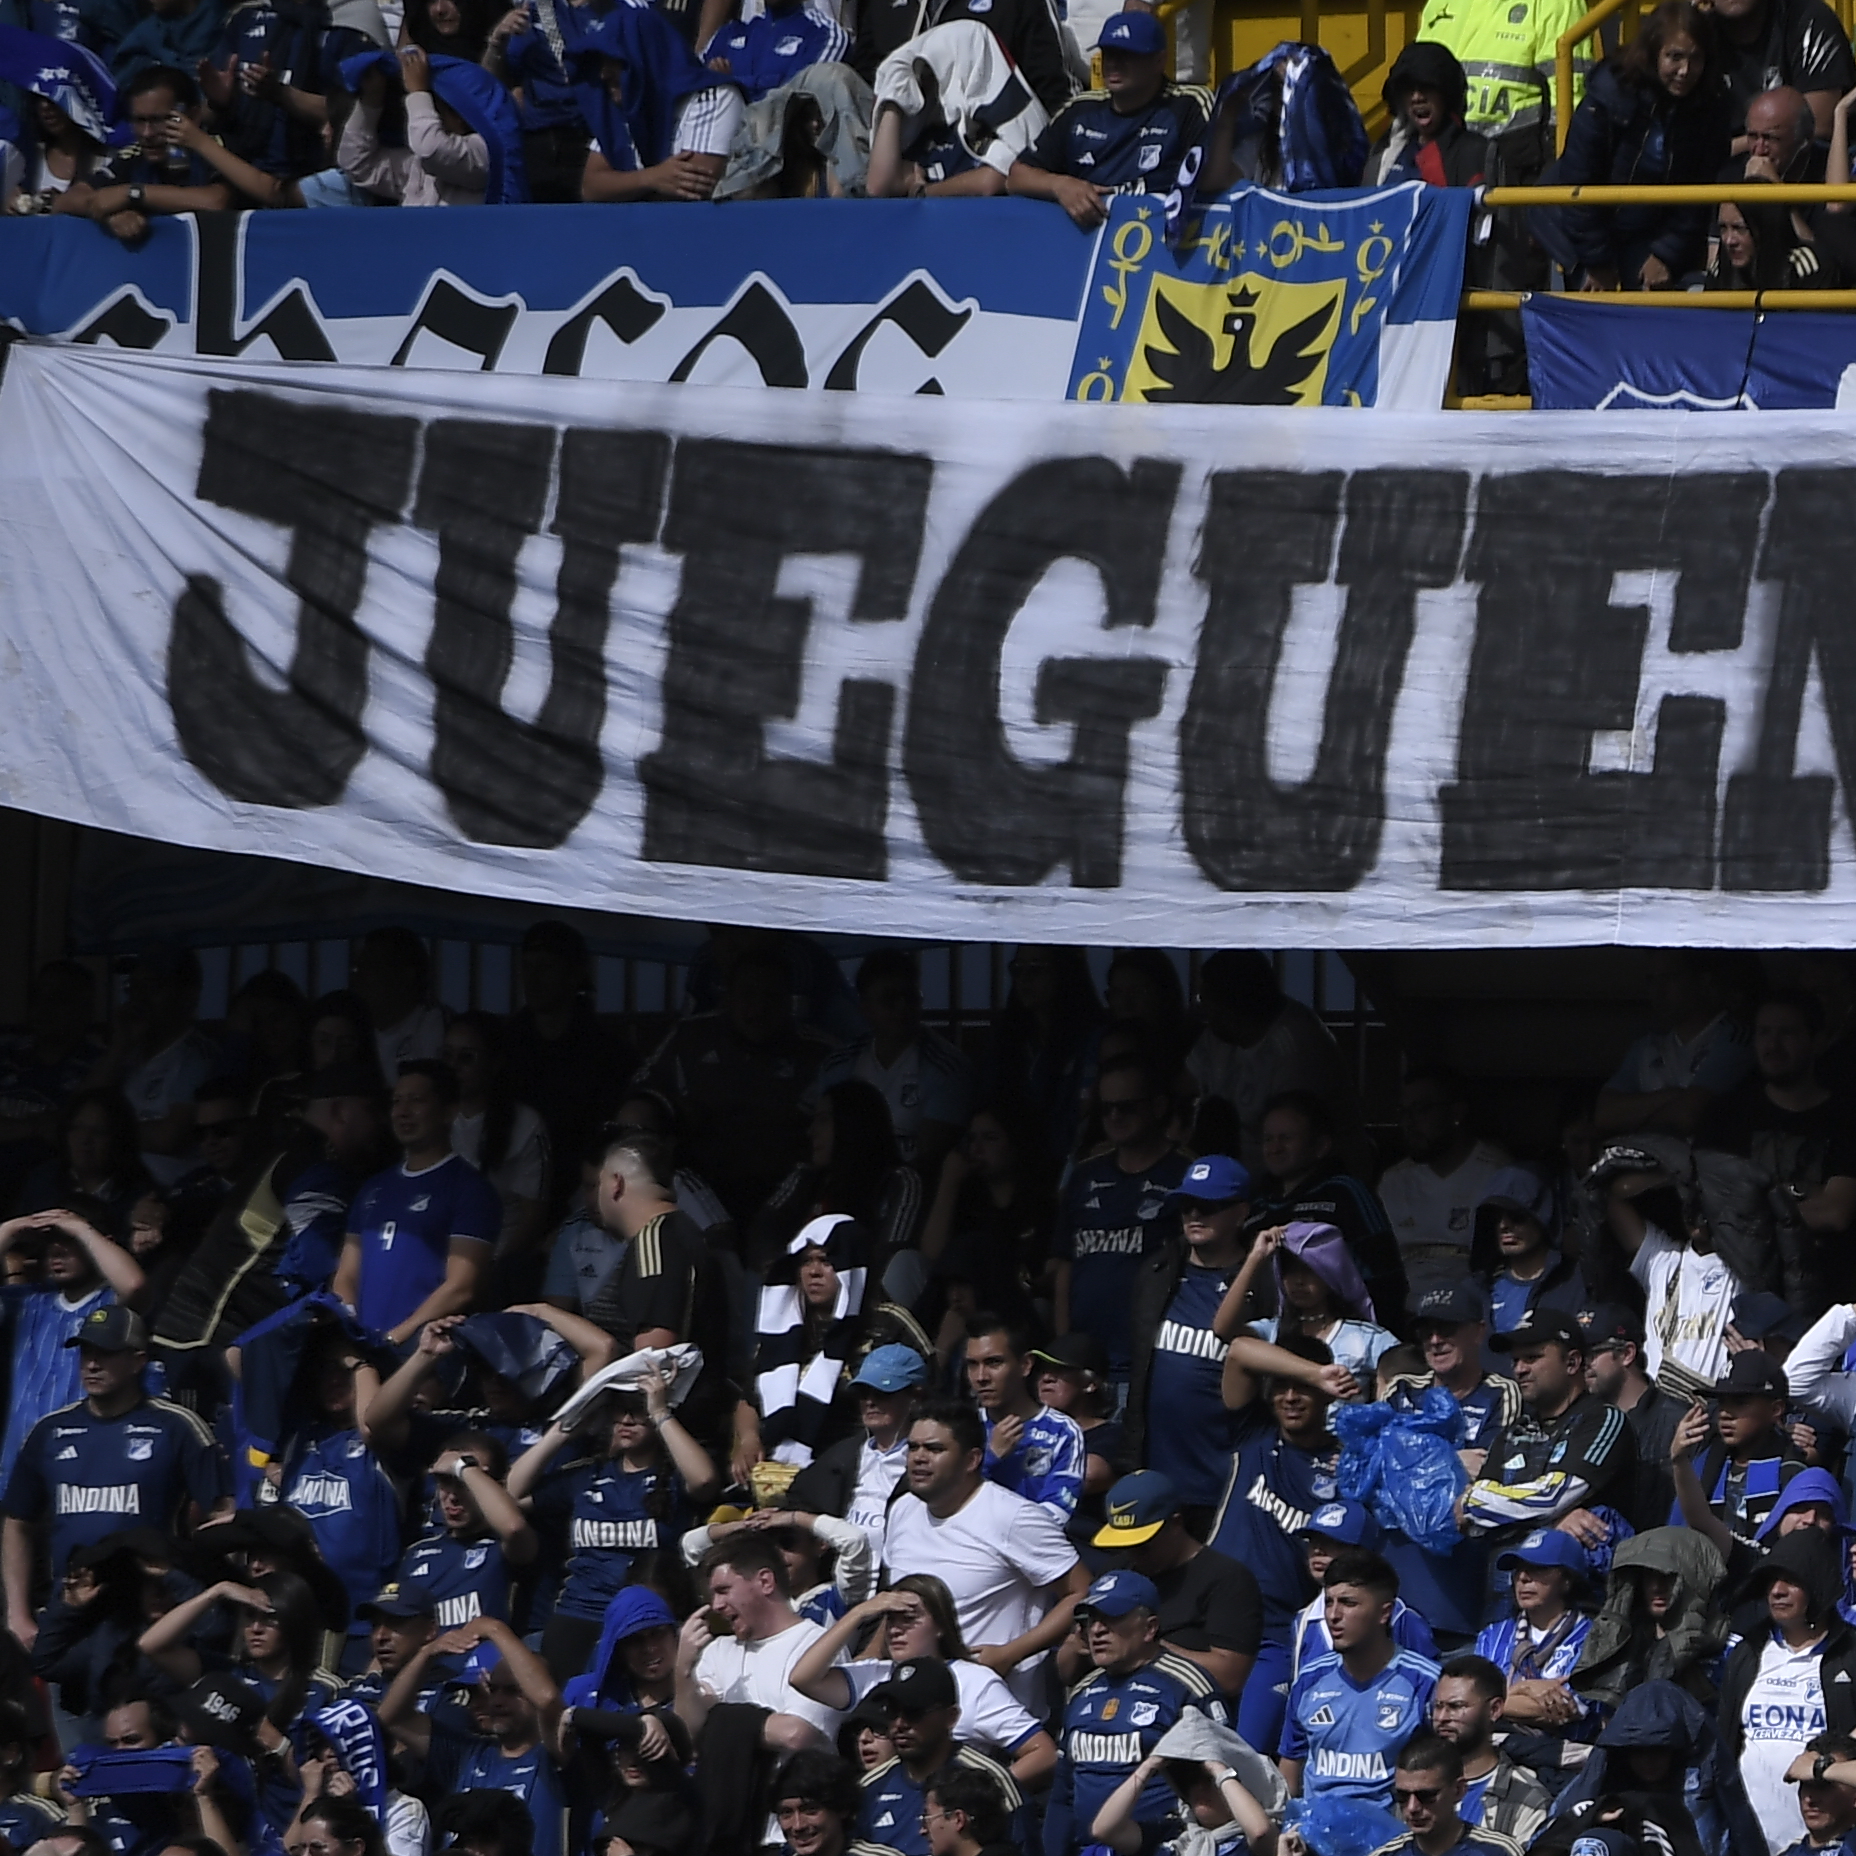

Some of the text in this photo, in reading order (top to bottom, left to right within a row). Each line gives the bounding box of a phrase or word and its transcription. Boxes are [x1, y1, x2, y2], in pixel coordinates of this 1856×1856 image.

[60, 1482, 139, 1516] ANDINA
[573, 1518, 658, 1549] ANDINA
[204, 1691, 242, 1722] 1946
[1071, 1731, 1141, 1763] ANDINA
[1753, 1730, 1801, 1742] CERVEZA
[1315, 1750, 1389, 1781] ANDINA
